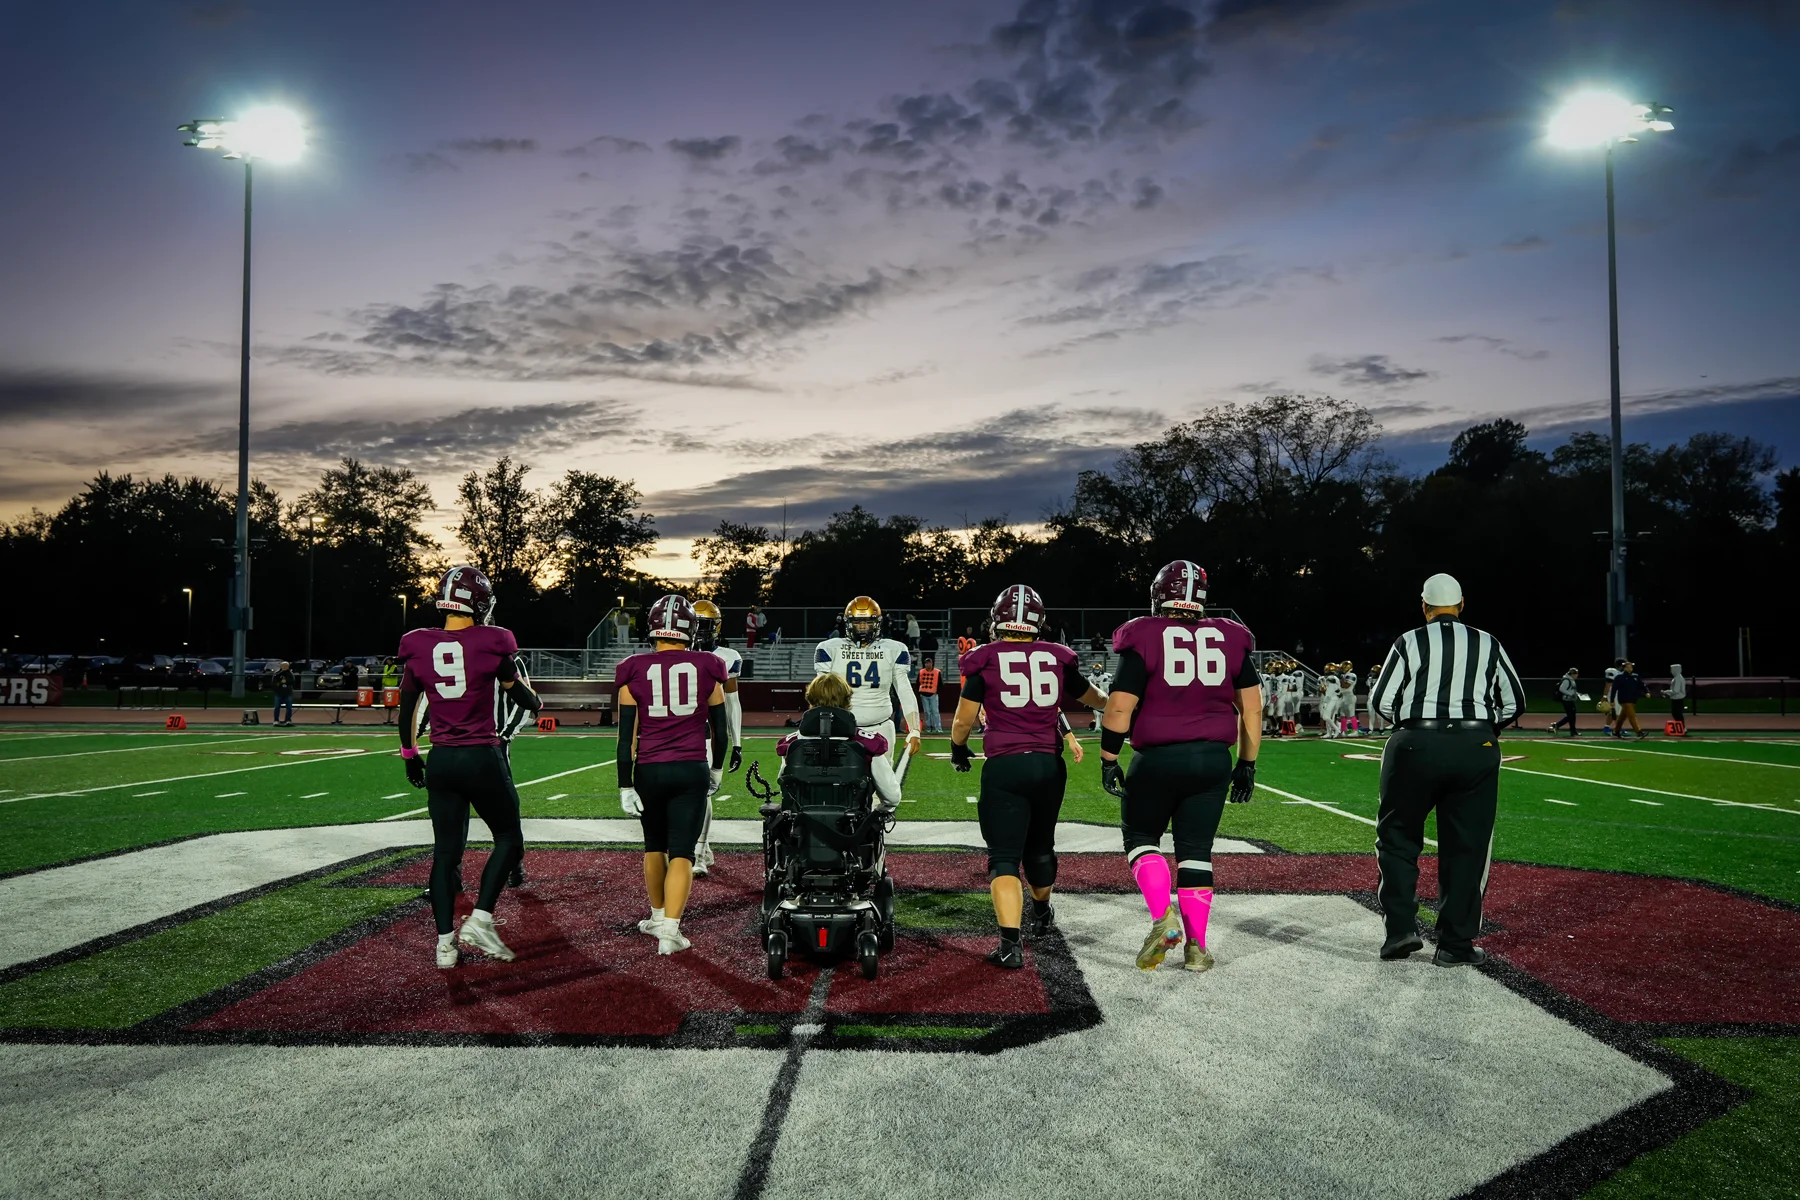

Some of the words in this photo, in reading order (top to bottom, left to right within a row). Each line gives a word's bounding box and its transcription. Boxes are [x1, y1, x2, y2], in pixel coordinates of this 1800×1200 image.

[1012, 592, 1031, 604] 56
[1173, 601, 1200, 610] Riddell
[1005, 623, 1032, 632] Riddell
[655, 630, 681, 638] Riddell
[842, 651, 864, 660] SWEET
[865, 651, 884, 660] HOME
[1162, 626, 1226, 687] 66
[432, 640, 467, 699] 9
[846, 661, 881, 688] 64
[997, 651, 1059, 708] 56
[646, 662, 698, 717] 10
[166, 716, 182, 728] 30
[540, 719, 553, 731] 40
[1668, 722, 1683, 734] 30
